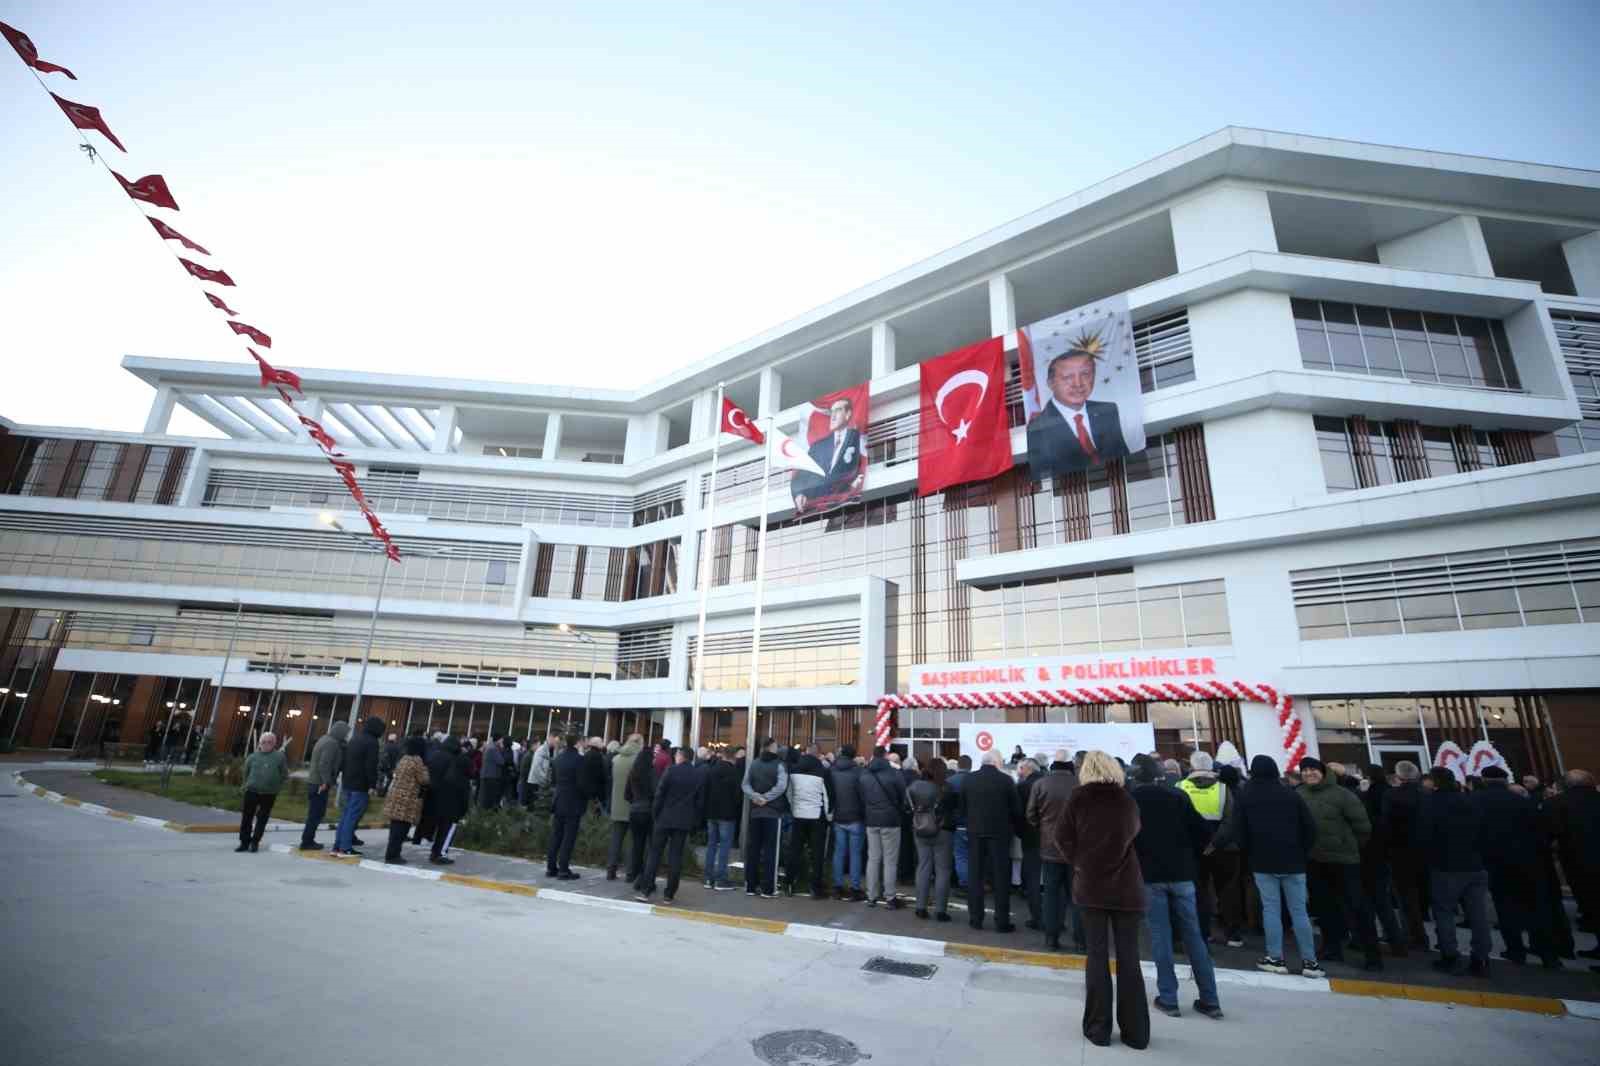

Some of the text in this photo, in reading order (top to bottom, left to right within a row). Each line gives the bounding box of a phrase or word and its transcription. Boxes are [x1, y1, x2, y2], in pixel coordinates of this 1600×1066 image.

[921, 656, 1216, 687] BAŞHEKİMLİK & POLİKLİNİKLER
